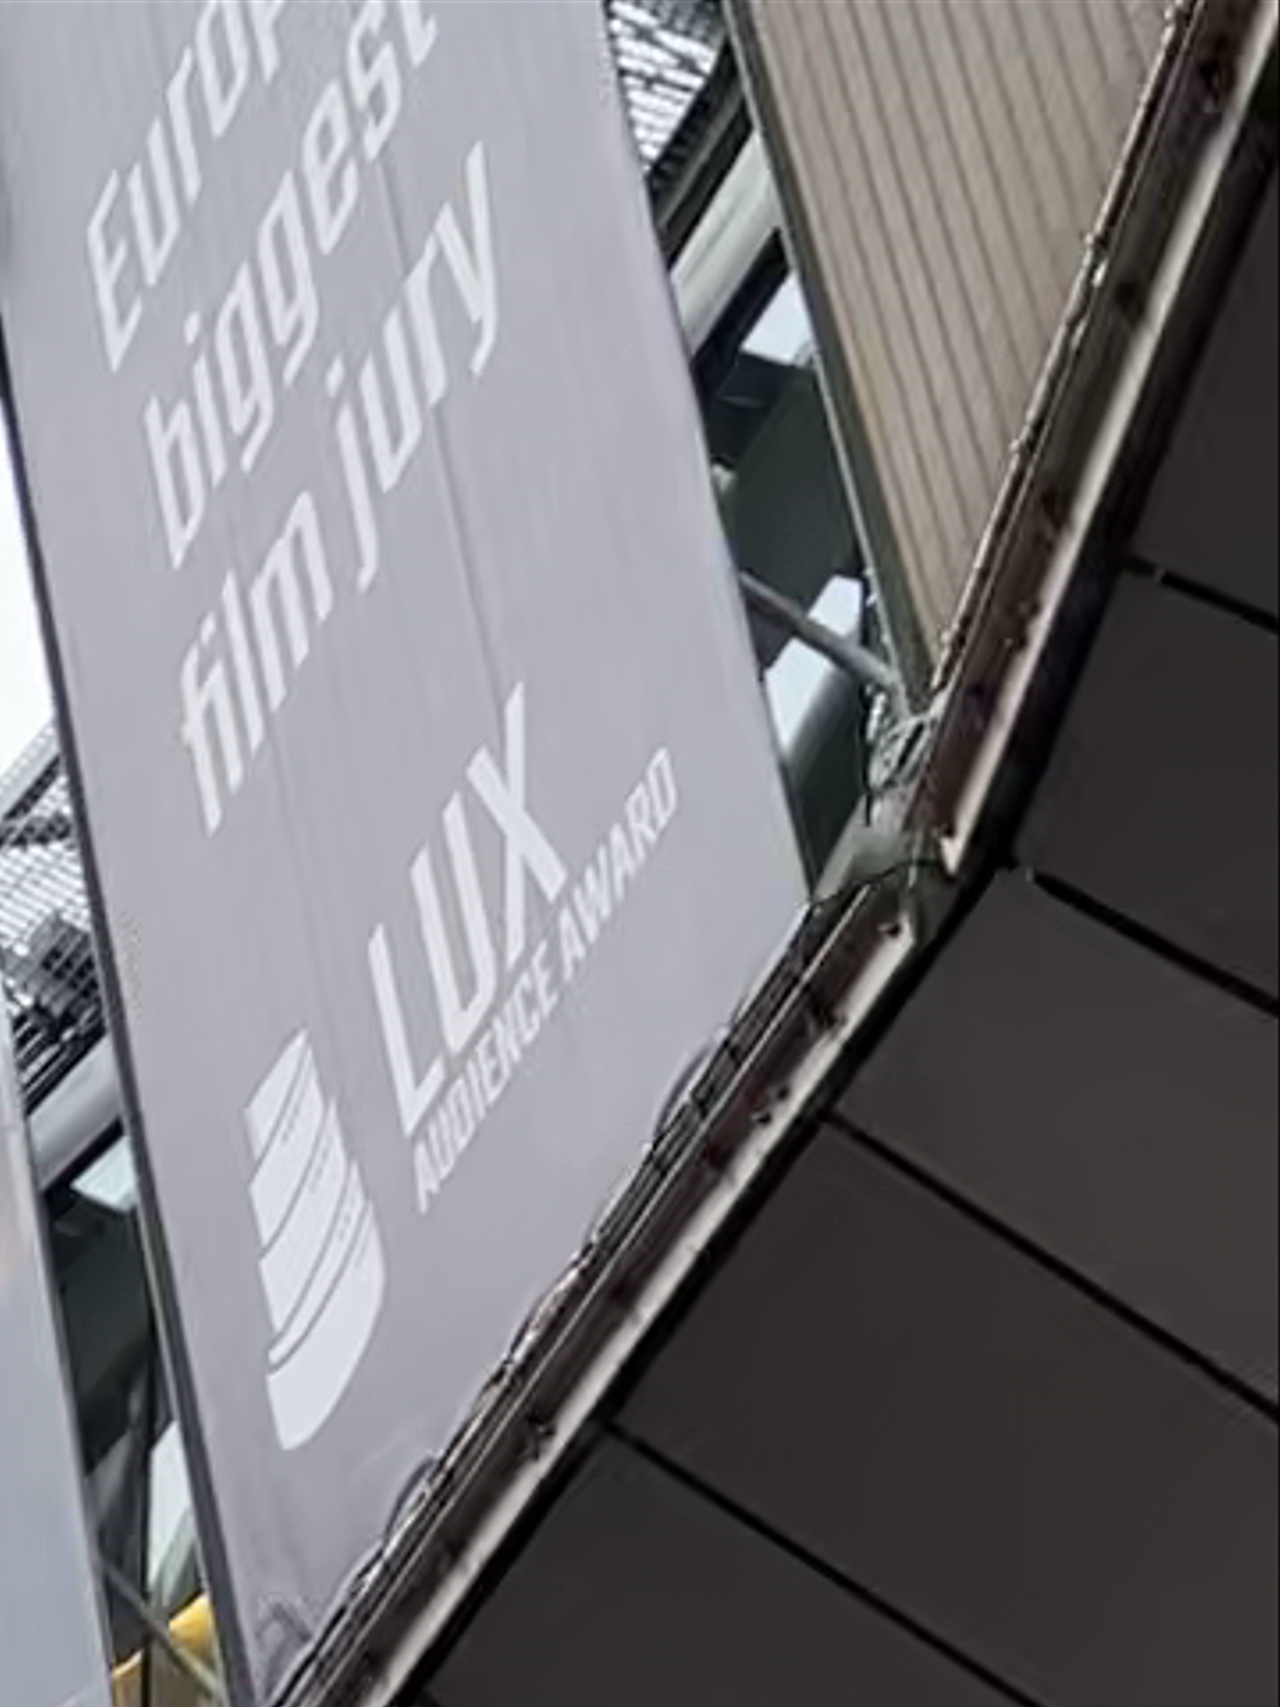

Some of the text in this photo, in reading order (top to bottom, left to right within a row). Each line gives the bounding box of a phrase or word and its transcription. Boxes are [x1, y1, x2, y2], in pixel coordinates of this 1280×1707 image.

[181, 139, 498, 838] film jury
[367, 679, 568, 1138] LUX
[413, 747, 680, 1214] AUDIENCE AWARD
